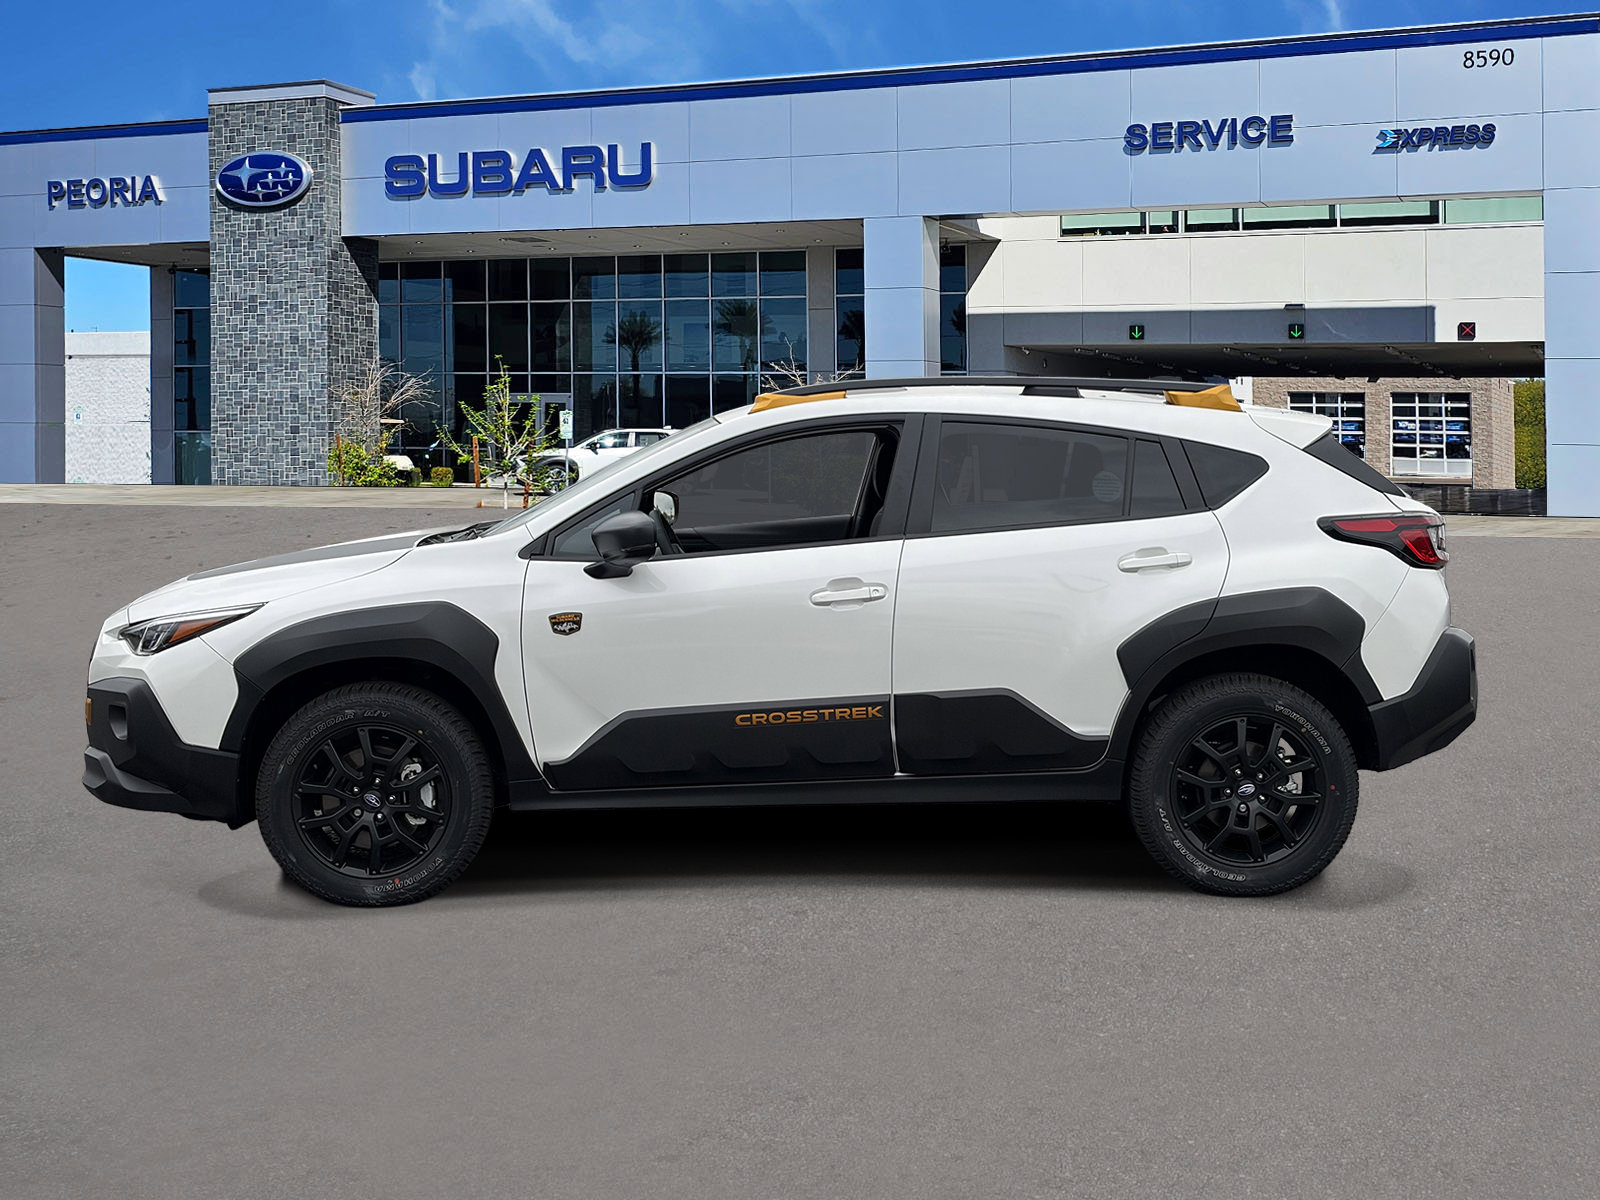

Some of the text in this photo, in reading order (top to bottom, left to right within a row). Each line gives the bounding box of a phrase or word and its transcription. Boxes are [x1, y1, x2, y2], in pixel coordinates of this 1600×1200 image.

[1463, 48, 1515, 69] 8590
[1124, 114, 1295, 151] SERVICE
[1376, 123, 1497, 149] EXPRESS
[384, 141, 653, 198] SUBARU
[47, 174, 163, 209] PEORIA
[735, 705, 884, 727] CROSSTREK
[1274, 704, 1332, 755] YOKOHAMA
